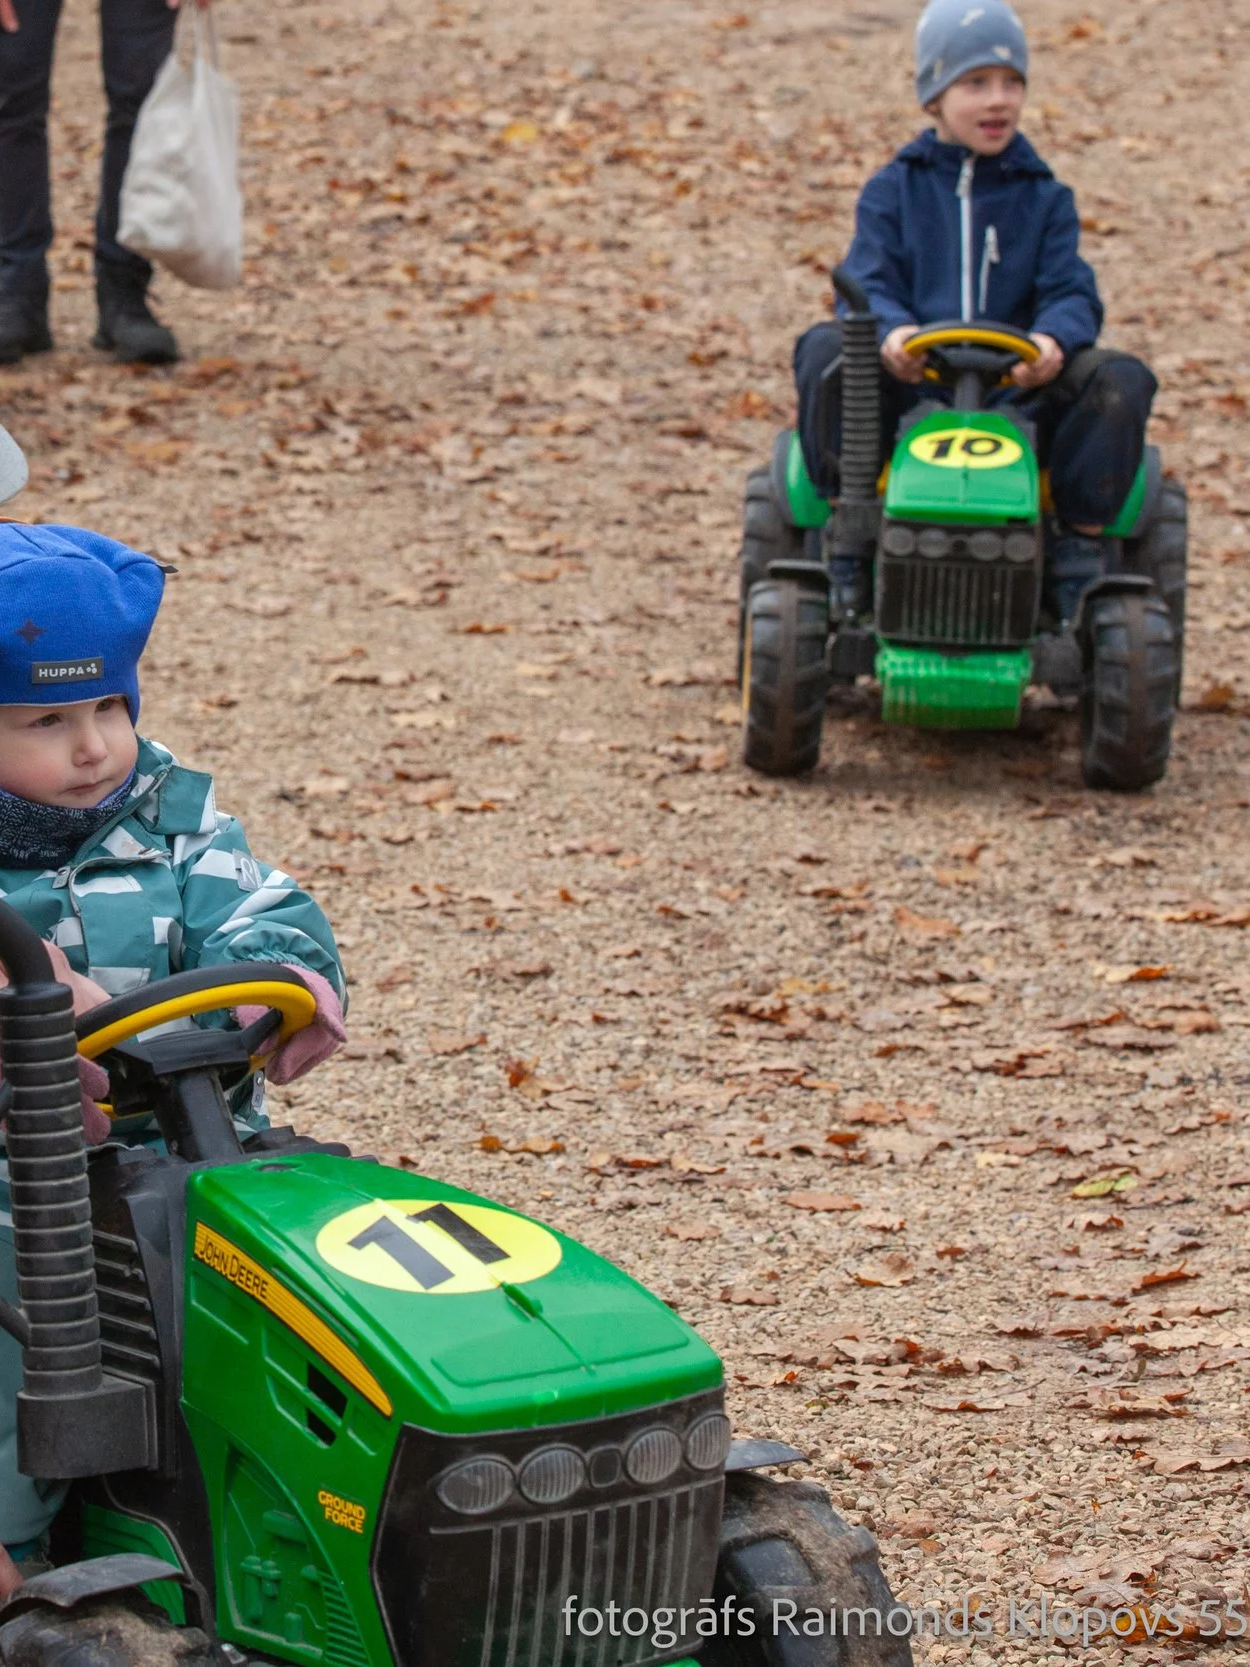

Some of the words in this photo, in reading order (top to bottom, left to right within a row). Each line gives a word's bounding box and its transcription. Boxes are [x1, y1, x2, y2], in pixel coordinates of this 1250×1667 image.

[928, 436, 1003, 460] 10
[38, 666, 85, 678] HUPPA
[199, 1235, 229, 1270] JOHN
[347, 1202, 512, 1290] 11
[318, 1490, 366, 1520] GROUND
[324, 1507, 364, 1534] FORCE
